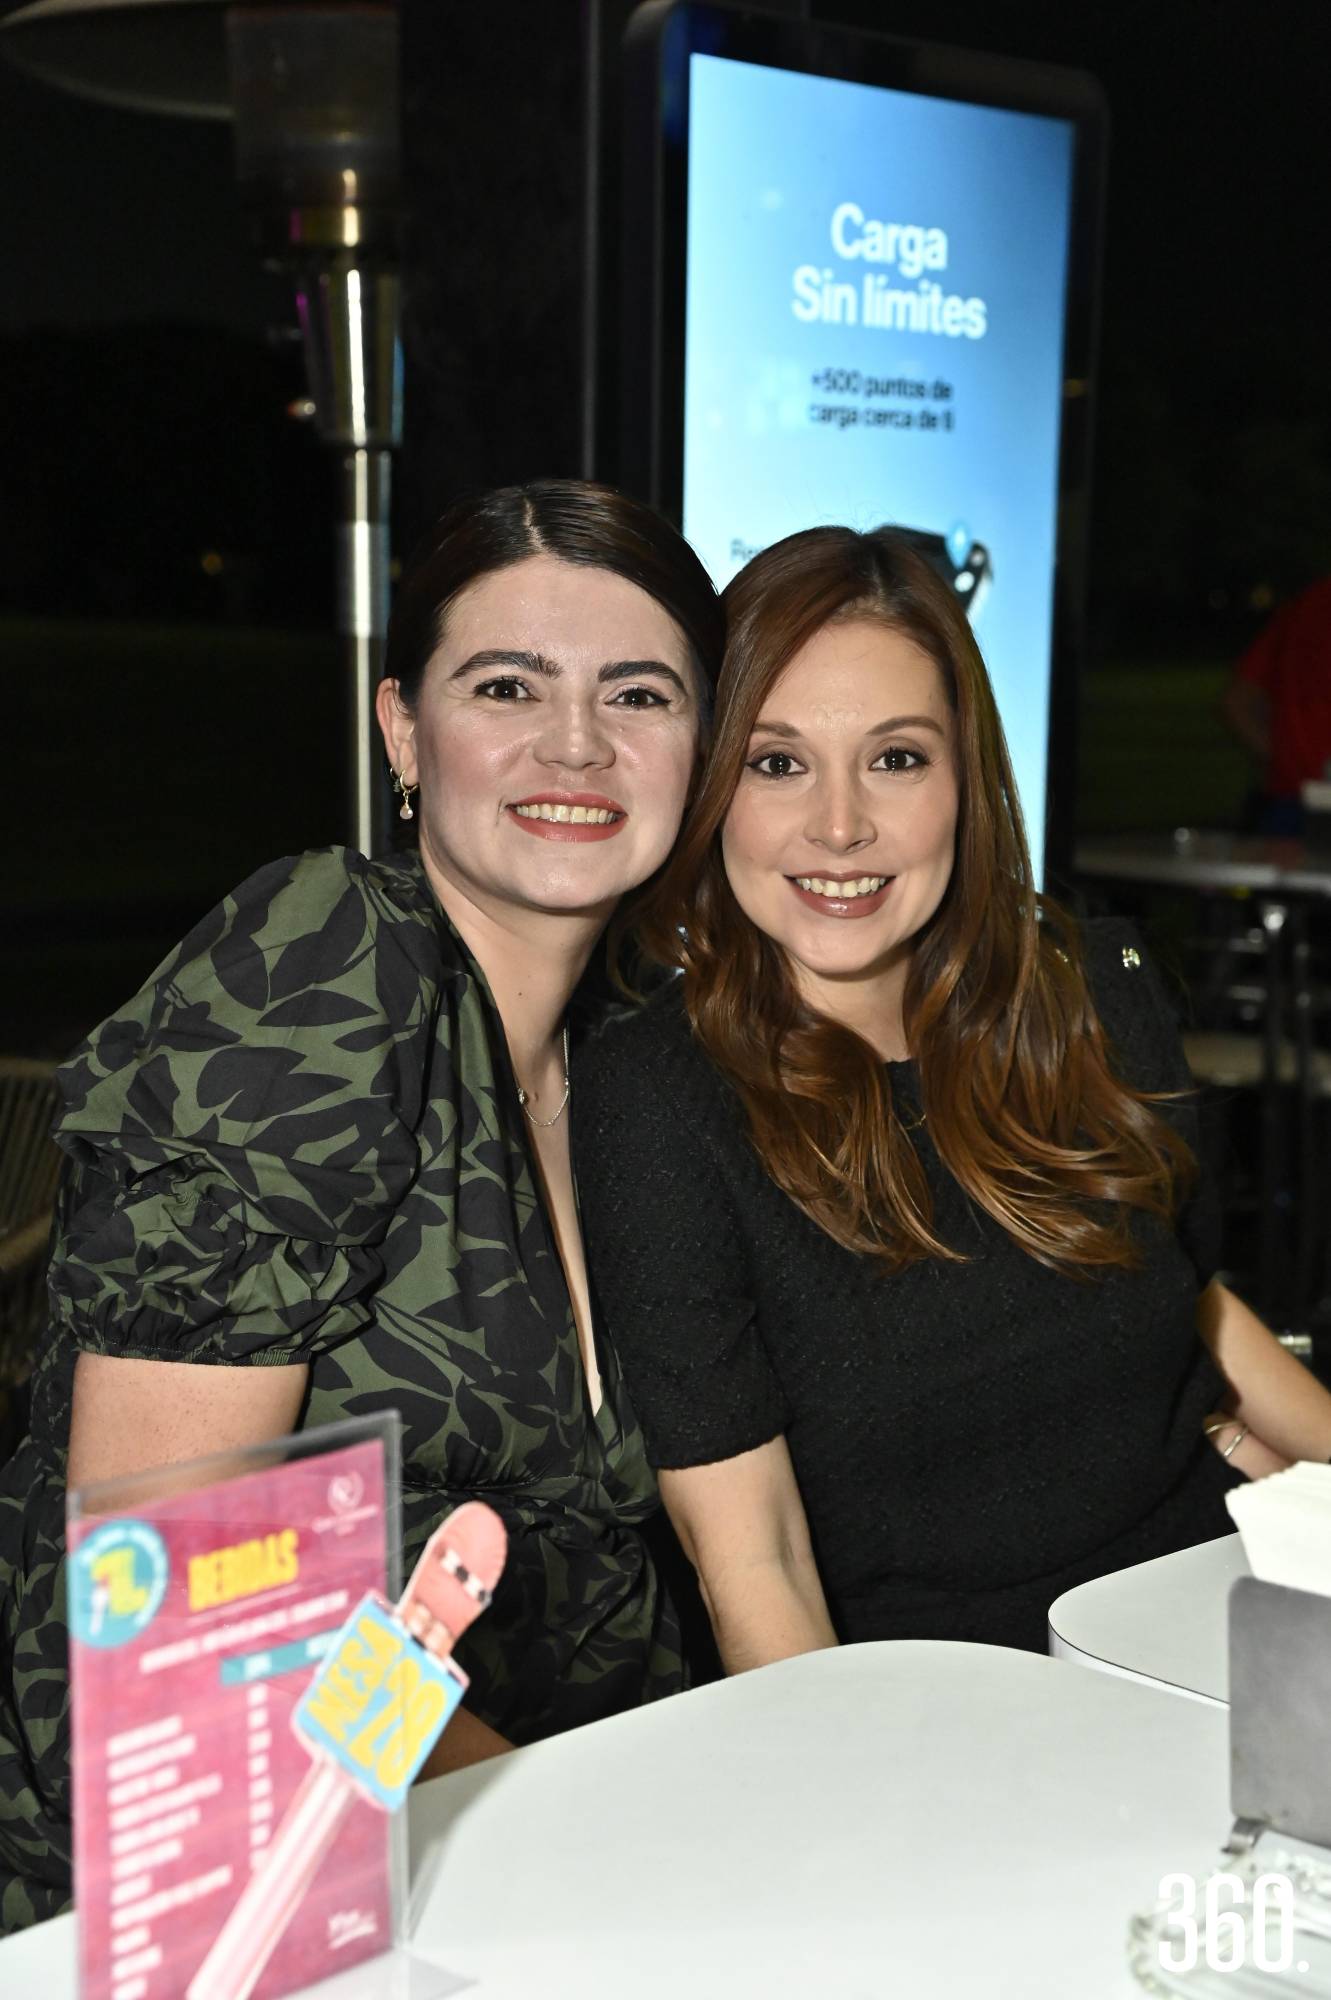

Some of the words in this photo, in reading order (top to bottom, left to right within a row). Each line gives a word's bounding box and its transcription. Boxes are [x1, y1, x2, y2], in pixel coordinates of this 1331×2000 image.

[831, 202, 948, 279] Carga
[792, 265, 858, 326] Sin
[862, 272, 987, 340] límites
[810, 404, 858, 430] carga
[863, 407, 912, 430] cerca
[918, 406, 938, 431] de
[864, 375, 926, 398] puntos
[932, 375, 953, 401] de
[307, 1616, 404, 1743] MESA
